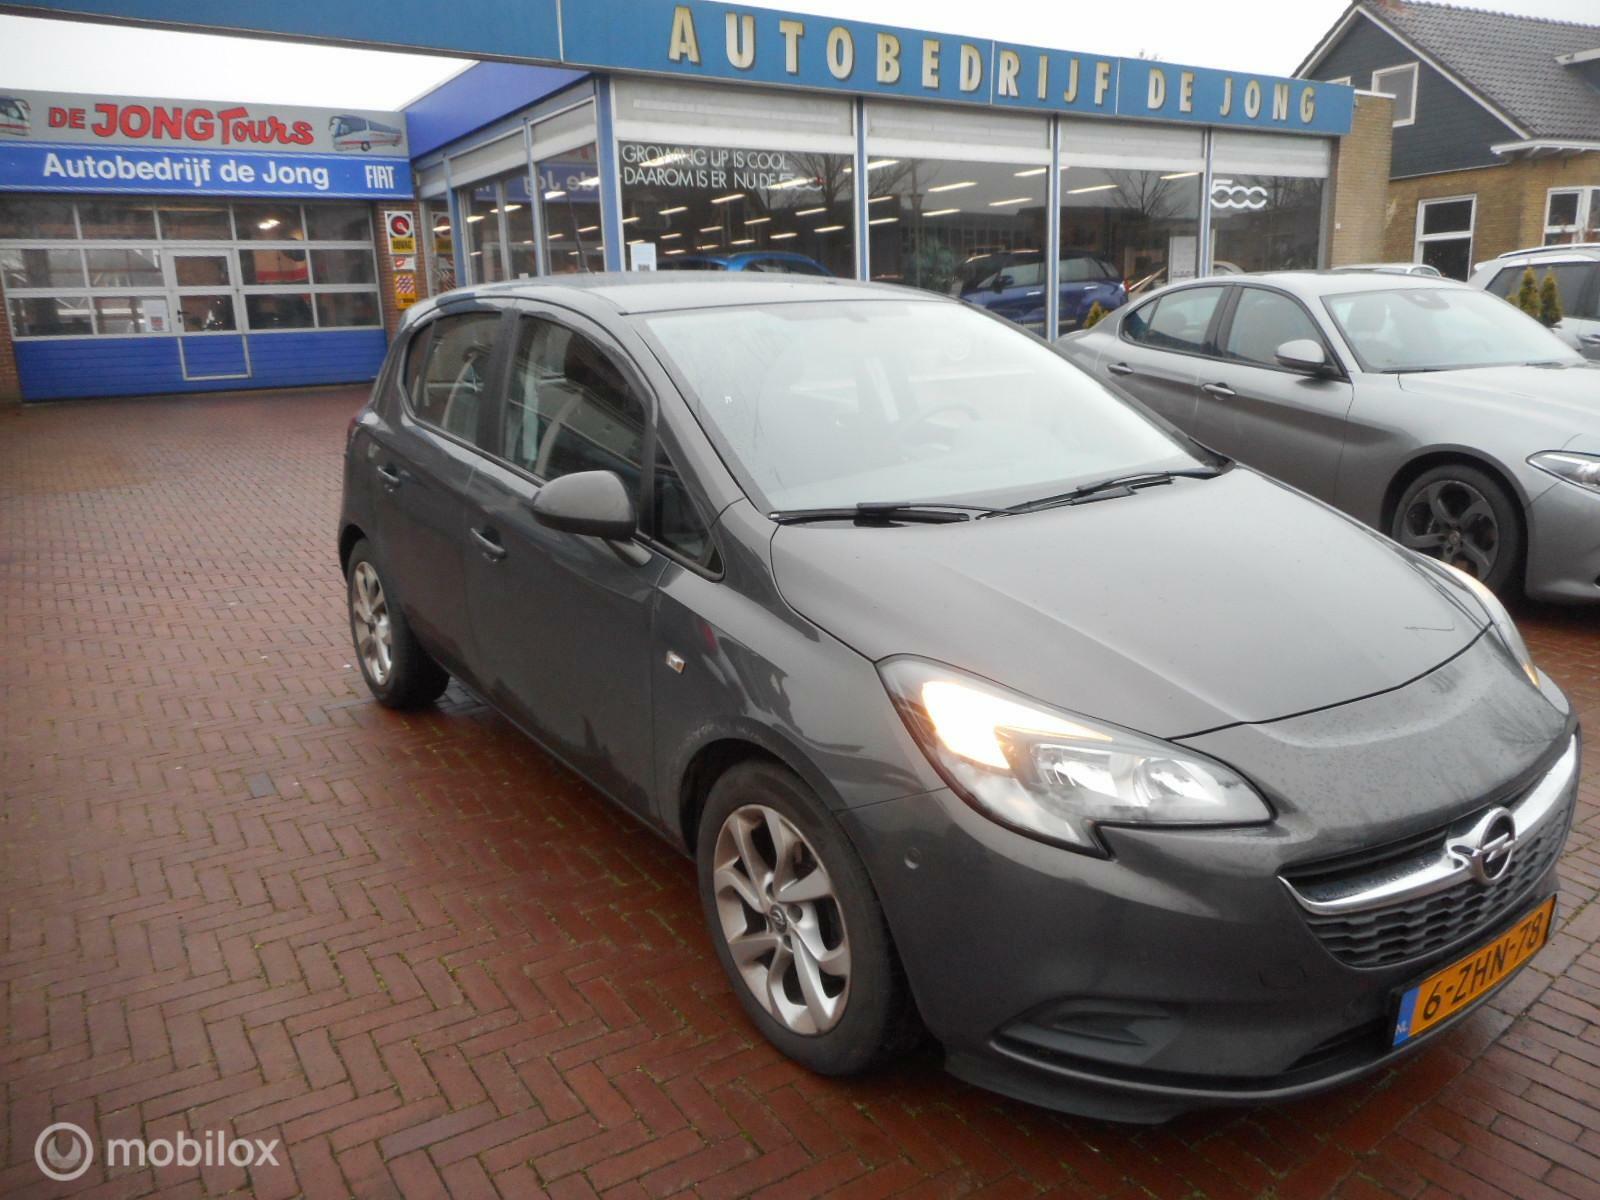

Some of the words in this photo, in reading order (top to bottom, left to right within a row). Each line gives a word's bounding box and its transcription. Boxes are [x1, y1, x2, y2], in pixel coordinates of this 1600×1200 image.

[668, 6, 1110, 105] AUTOBEDRIJF
[1147, 68, 1193, 112] DE
[1219, 76, 1315, 124] JONG
[48, 107, 86, 129] DE
[91, 103, 215, 141] JONG
[217, 106, 314, 145] Tours
[43, 152, 211, 187] Autobedrijf
[219, 159, 255, 183] de
[262, 160, 329, 190] Jong
[622, 144, 706, 166] GROWING
[710, 148, 730, 168] UP
[733, 151, 745, 169] IS
[747, 152, 790, 170] COOL
[365, 165, 394, 189] FIAT
[624, 166, 693, 186] DAAROM
[696, 169, 708, 188] IS
[712, 170, 727, 188] ER
[734, 172, 756, 190] NU
[1211, 179, 1268, 209] 500
[1422, 911, 1544, 1020] 6-ZHN-78
